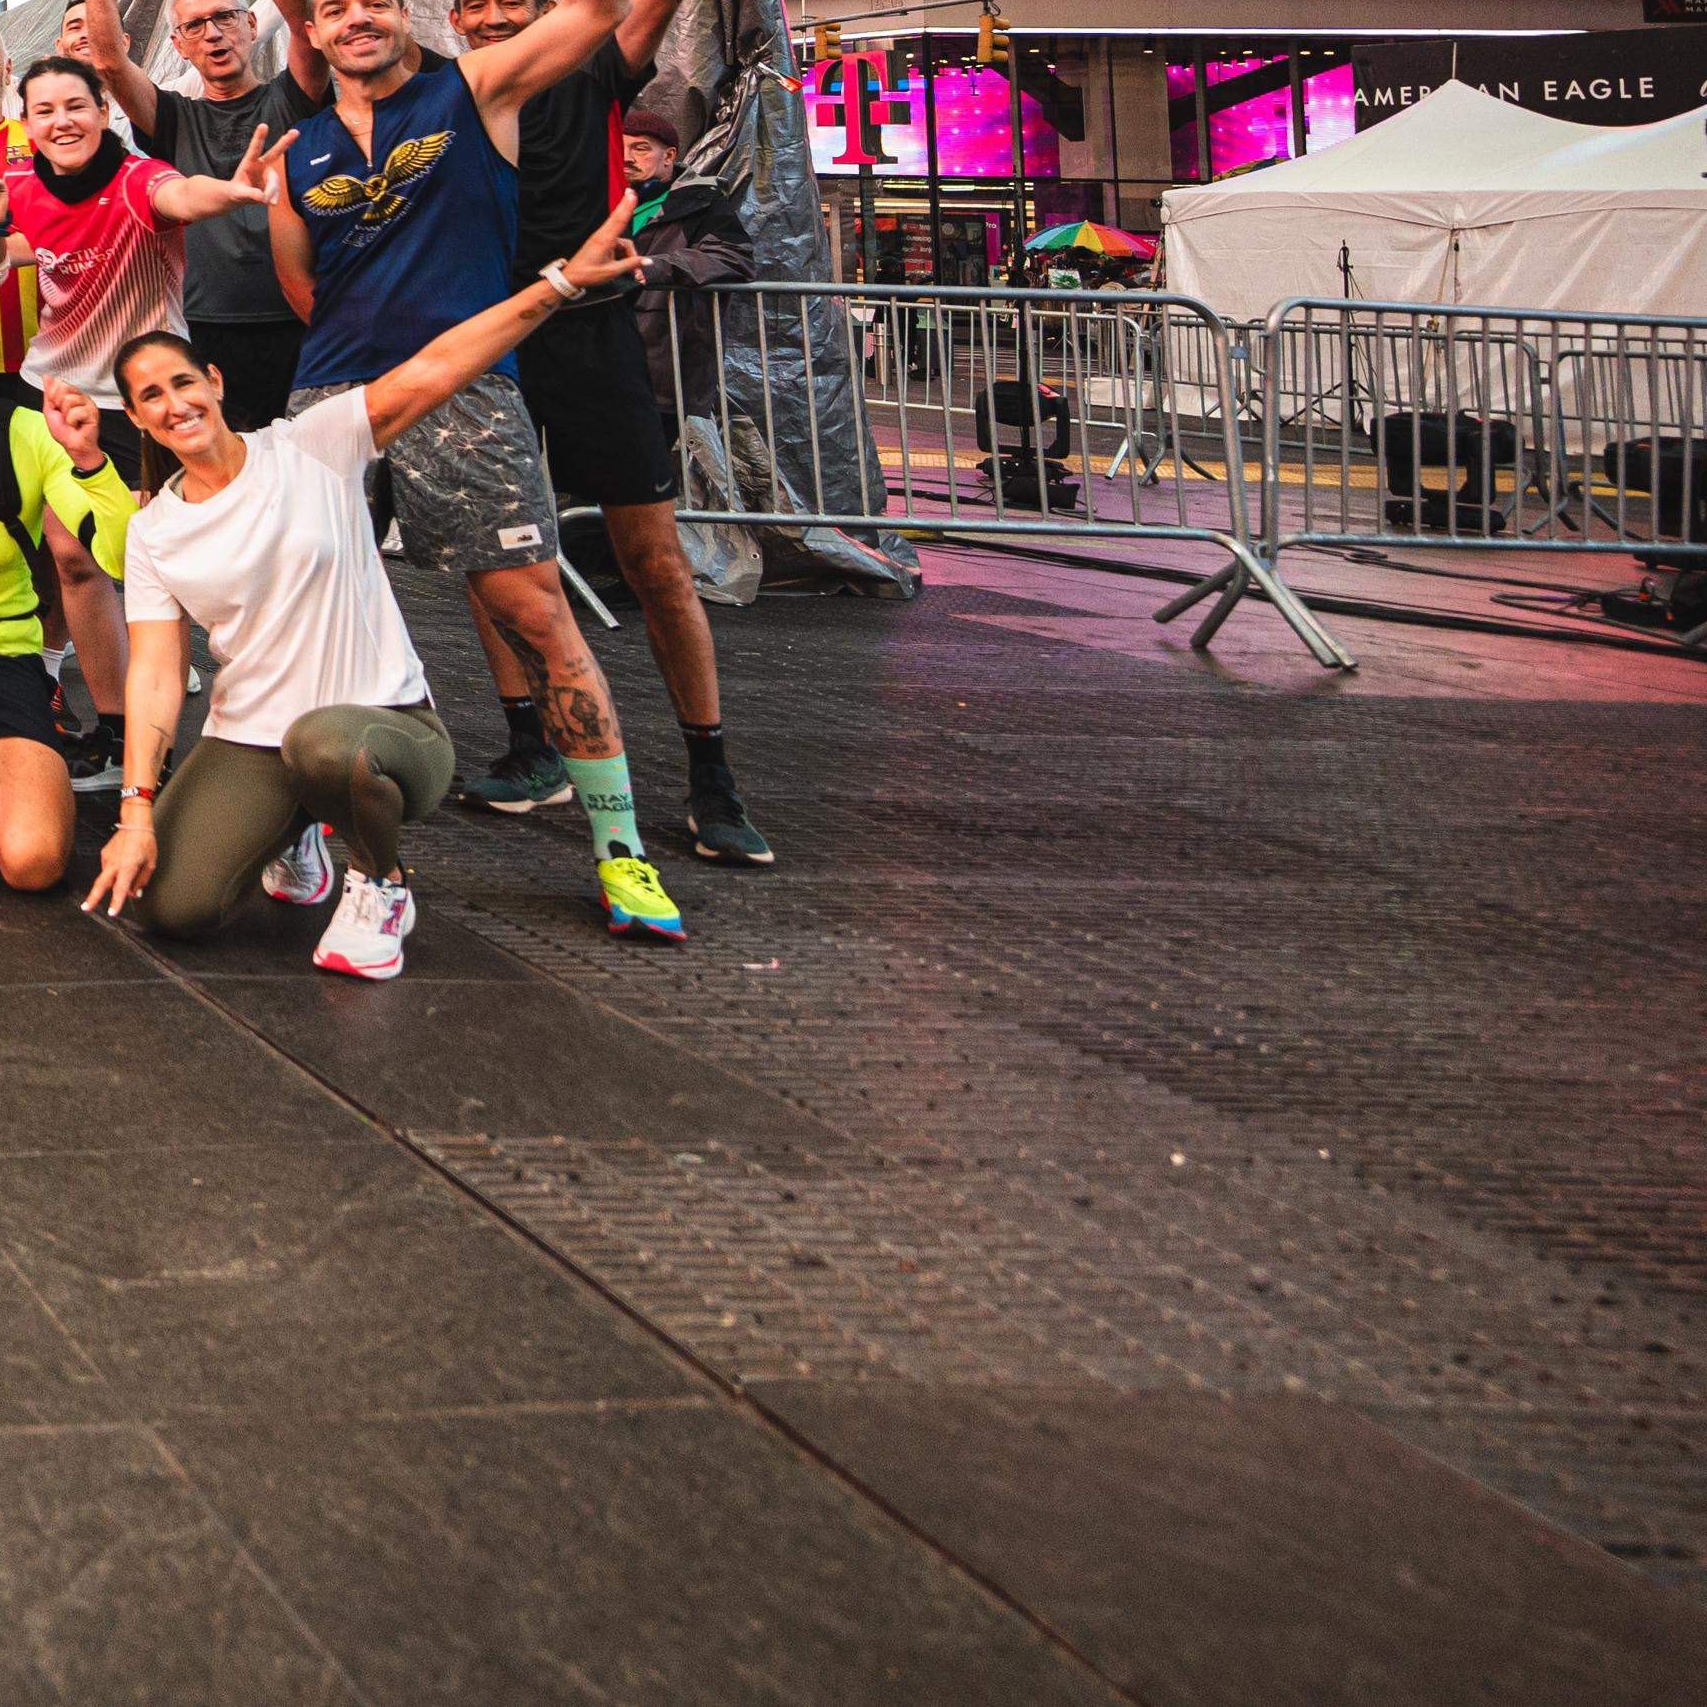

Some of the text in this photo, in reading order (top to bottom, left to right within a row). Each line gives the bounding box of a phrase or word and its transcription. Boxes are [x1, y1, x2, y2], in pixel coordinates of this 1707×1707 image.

[1544, 77, 1655, 102] EAGLE
[815, 50, 892, 165] T
[588, 794, 629, 803] STAY
